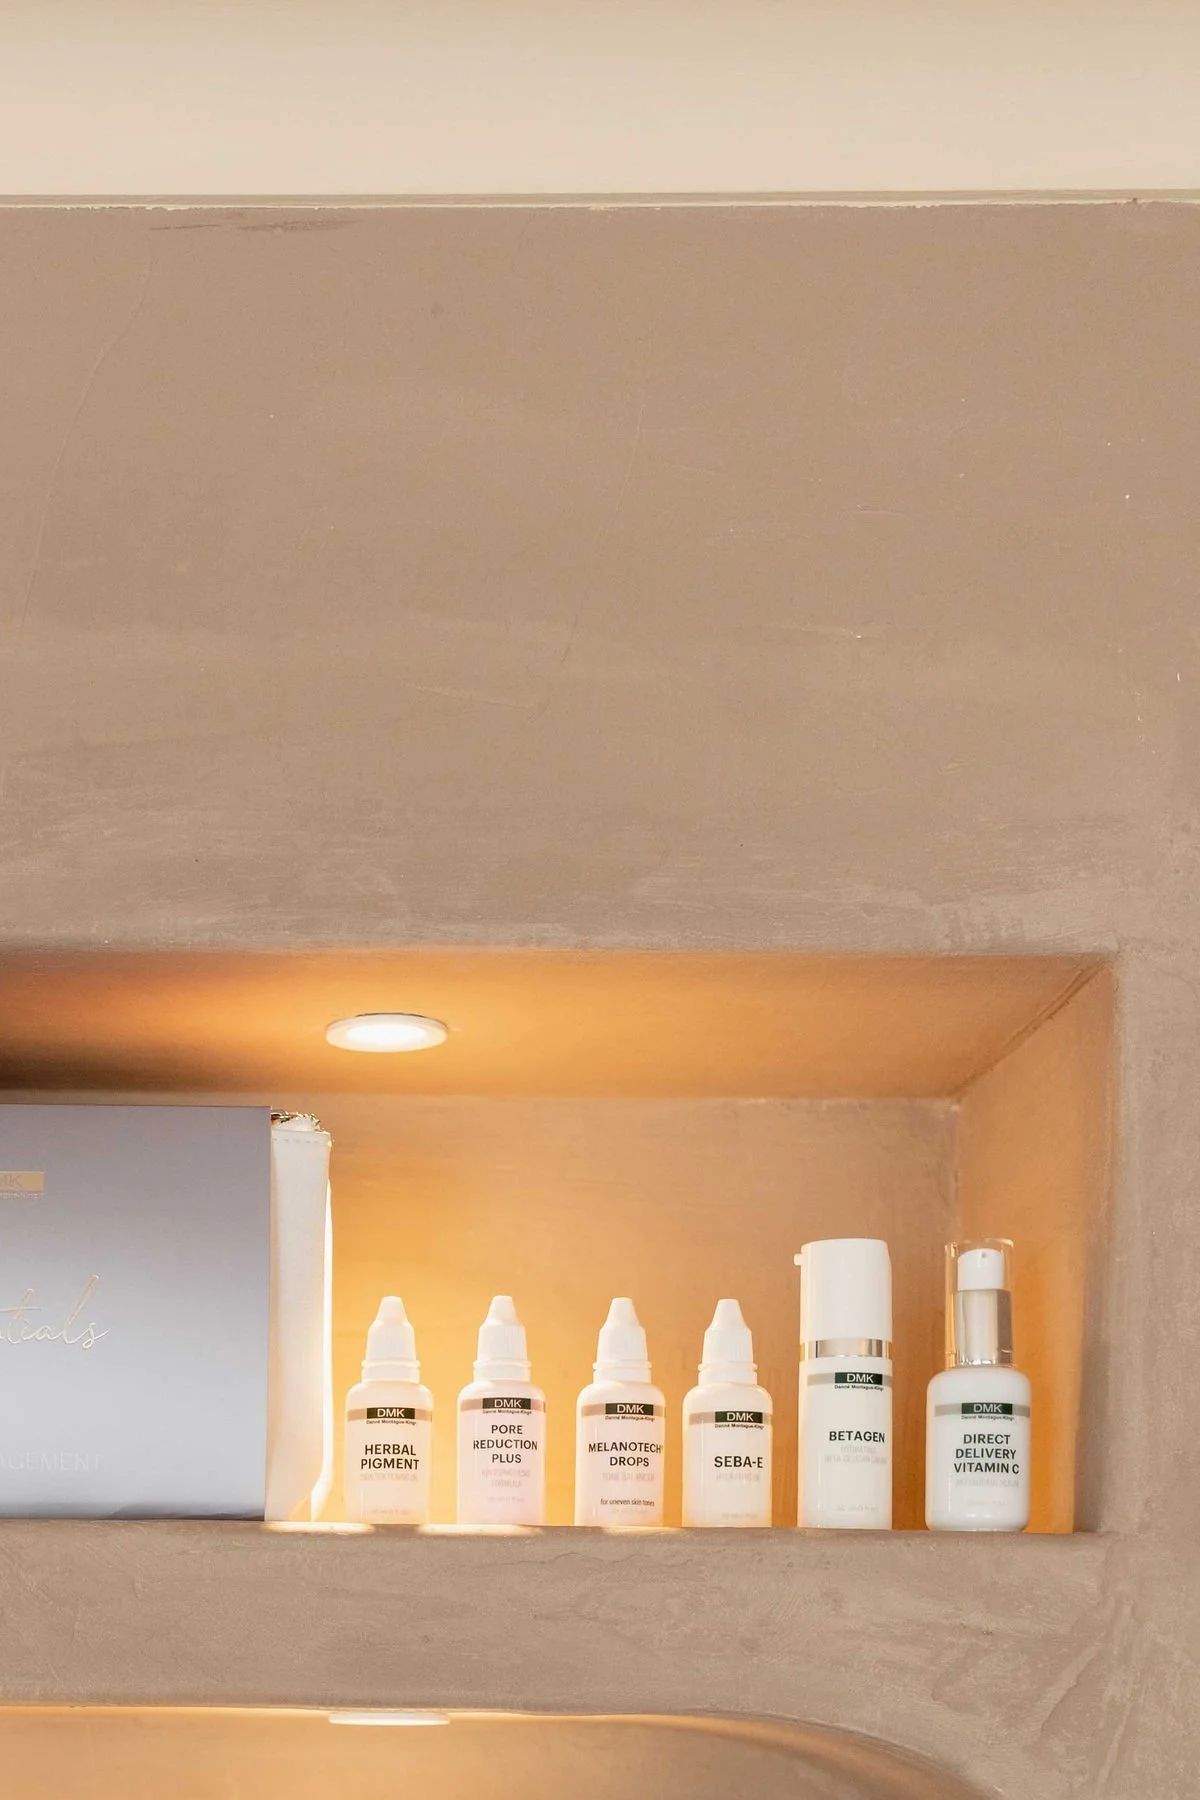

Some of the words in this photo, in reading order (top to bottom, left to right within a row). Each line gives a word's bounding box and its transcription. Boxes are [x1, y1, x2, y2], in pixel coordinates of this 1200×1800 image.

[846, 1373, 874, 1383] DMK
[494, 1399, 522, 1408] DMK
[617, 1404, 645, 1414] DMK
[973, 1403, 1002, 1413] DMK
[377, 1408, 405, 1418] DMK
[726, 1412, 754, 1422] DMK
[491, 1425, 524, 1435] PORE
[829, 1431, 886, 1443] BETAGEN
[962, 1433, 1011, 1445] DIRECT
[364, 1444, 417, 1456] HERBAL
[472, 1440, 539, 1451] REDUCTION
[491, 1454, 522, 1464] PLUS
[955, 1448, 1017, 1460] DELIVERY
[360, 1459, 421, 1470] PIGMENT
[609, 1456, 650, 1468] DROPS
[714, 1456, 764, 1469] SEBA-E
[953, 1462, 1010, 1474] VITAMIN
[1011, 1463, 1020, 1475] C
